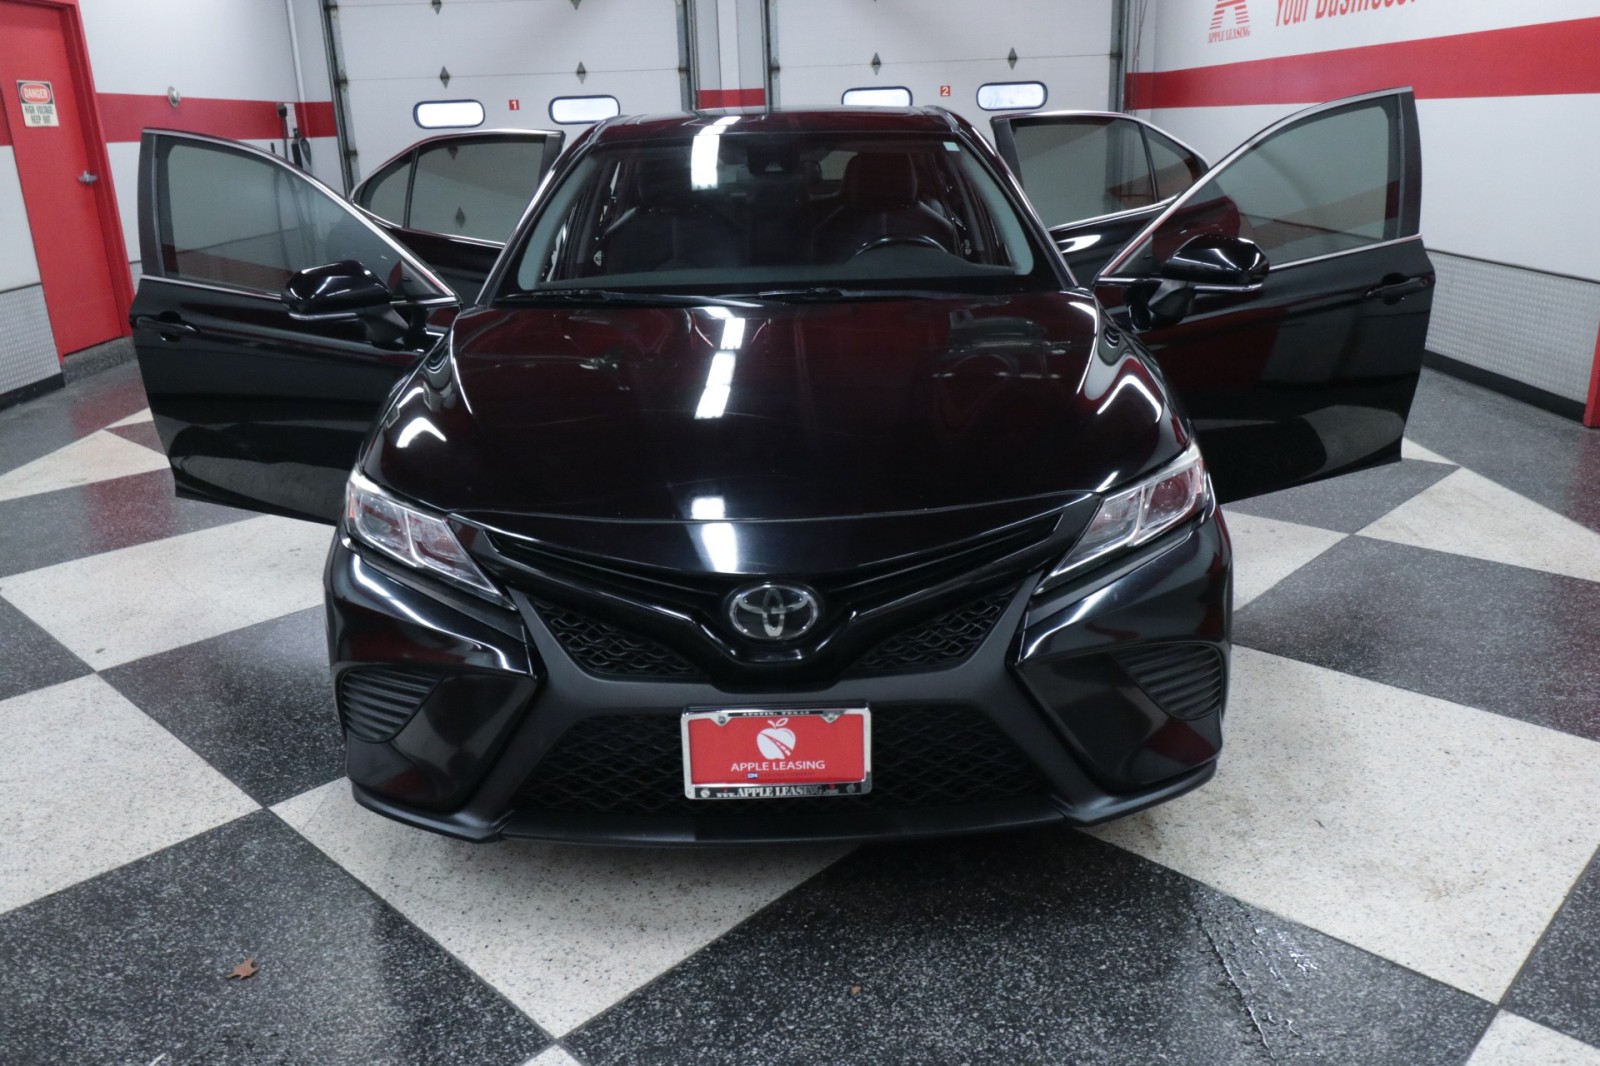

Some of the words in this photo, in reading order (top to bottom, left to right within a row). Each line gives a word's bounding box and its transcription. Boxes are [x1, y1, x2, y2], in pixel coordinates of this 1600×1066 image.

[1208, 30, 1225, 43] APPLE
[1226, 26, 1250, 40] LEASING
[23, 87, 49, 99] DANGER
[24, 105, 36, 114] HIGH
[36, 105, 54, 115] VOLTAGE
[30, 115, 42, 124] KEEP
[42, 115, 51, 124] OUT
[730, 761, 770, 772] APPLE
[772, 760, 826, 771] LEASING
